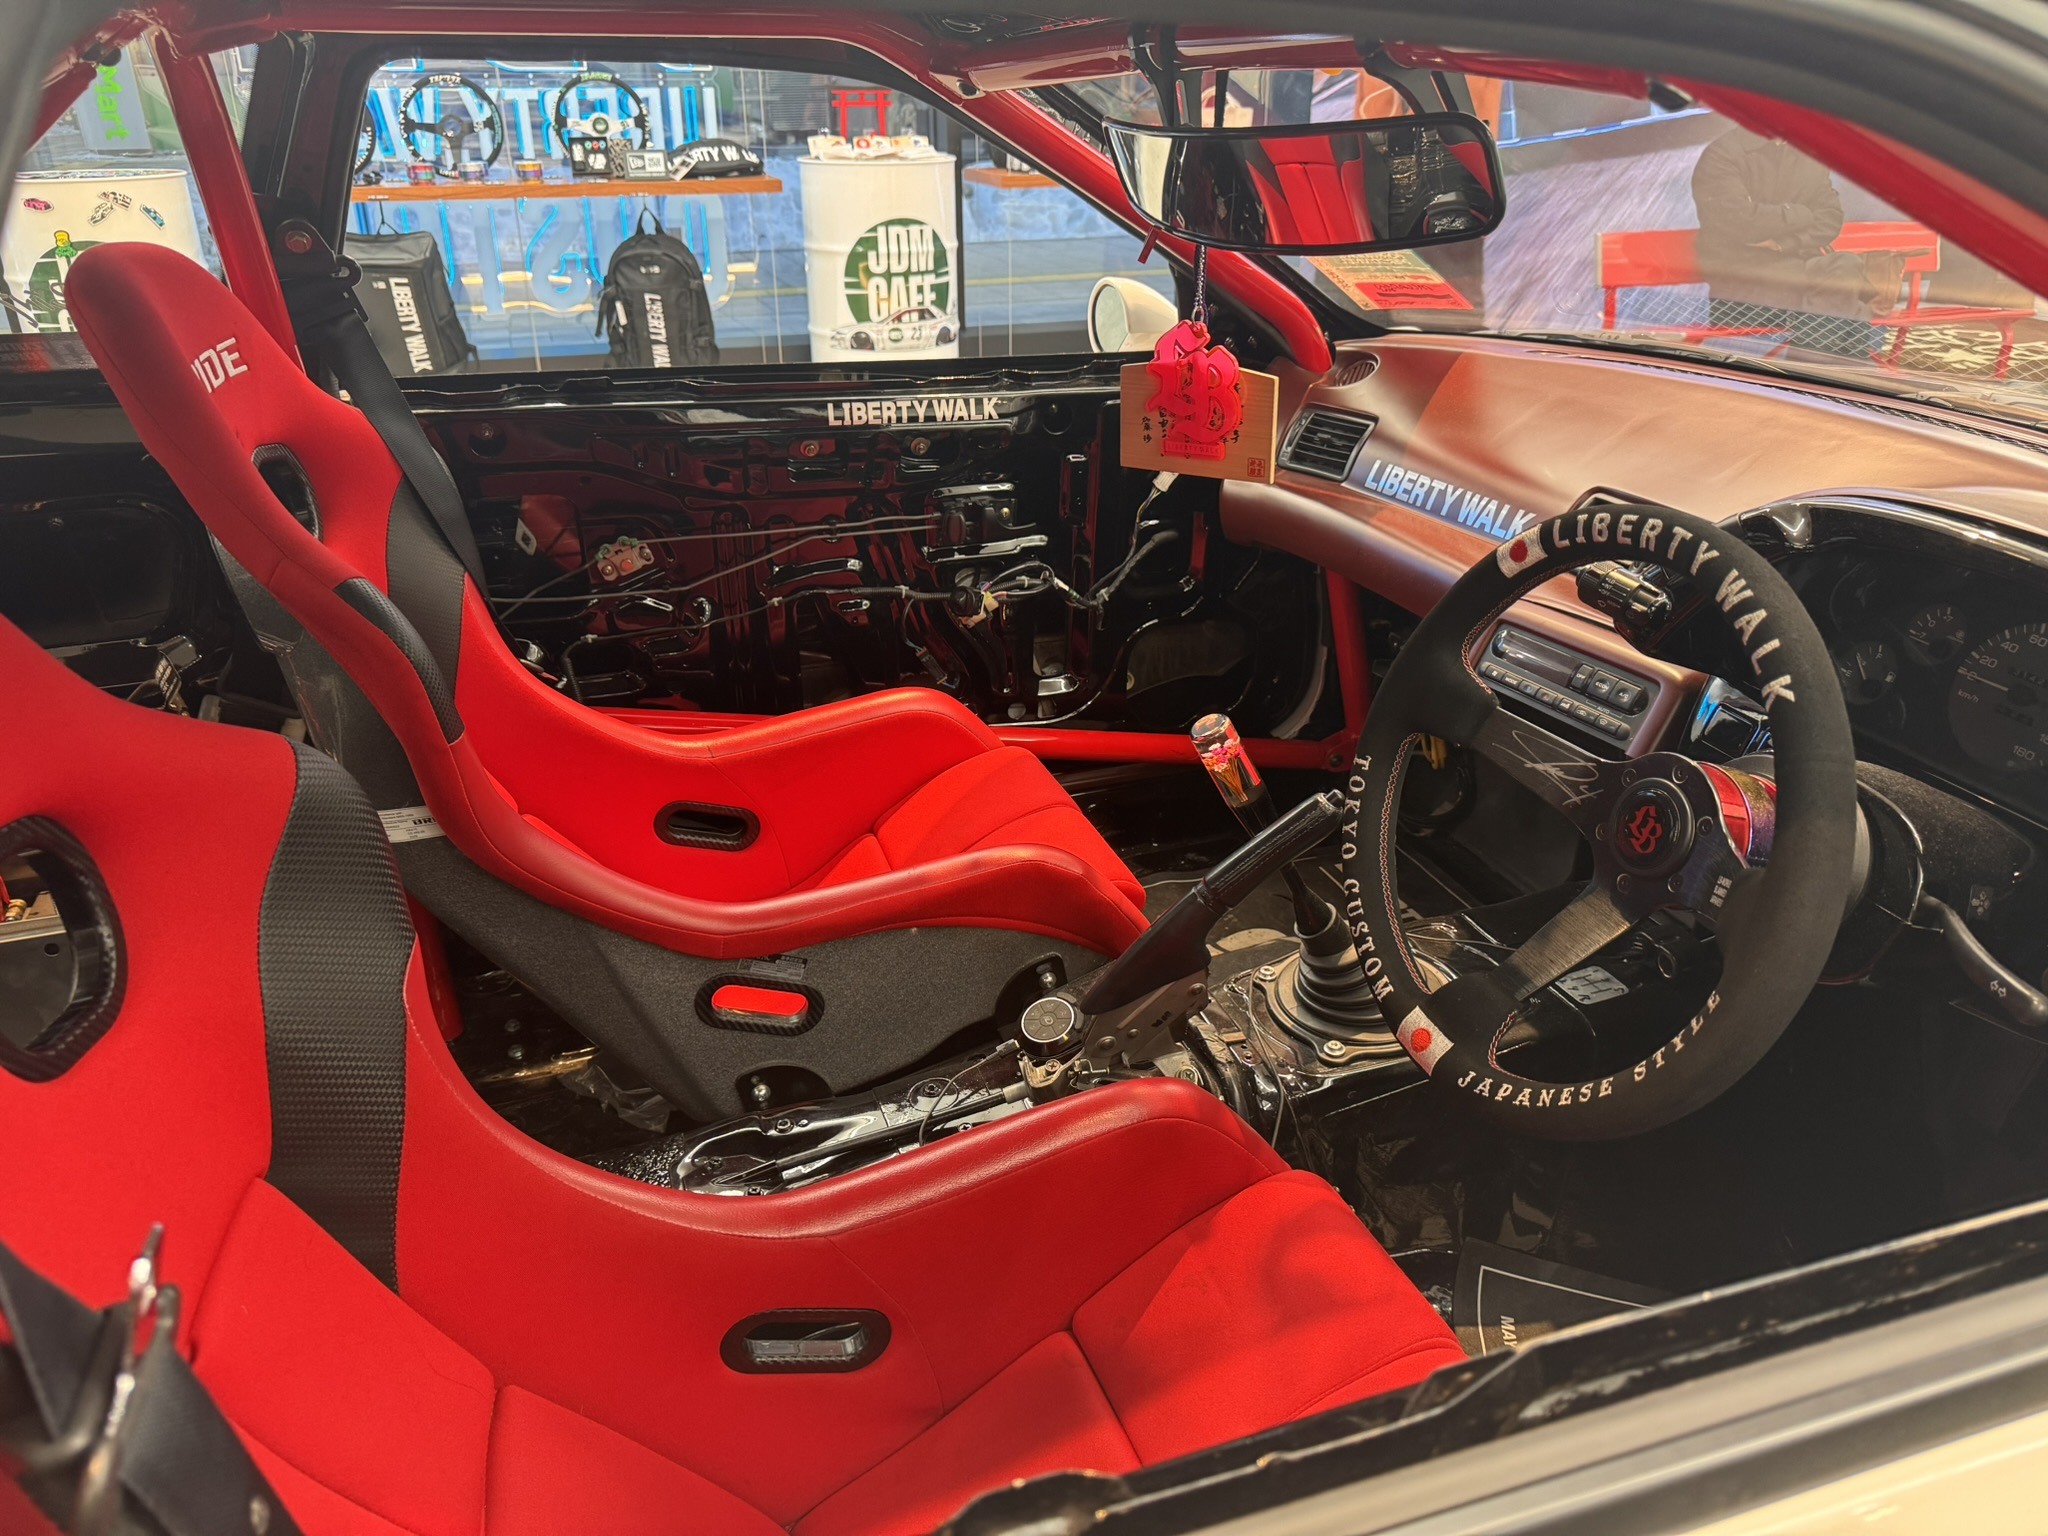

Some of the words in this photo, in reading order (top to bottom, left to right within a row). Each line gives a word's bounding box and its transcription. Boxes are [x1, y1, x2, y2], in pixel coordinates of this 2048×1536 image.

[867, 223, 935, 274] JDM
[388, 277, 423, 332] LIBERTY
[643, 292, 668, 343] LIBERTY
[190, 336, 249, 394] IDE
[404, 334, 433, 374] WALK
[826, 400, 928, 426] LIBERTY
[931, 397, 1000, 422] WALK
[1364, 459, 1465, 517] LIBERTY
[1456, 490, 1537, 541] WALK
[1552, 512, 1720, 577] LIBERTY
[1715, 568, 1796, 713] WALK
[1979, 655, 1998, 669] 20
[2000, 641, 2020, 654] 40
[2028, 633, 2048, 648] 60
[1594, 681, 1611, 691] ECON
[1618, 692, 1630, 701] A/C
[1957, 689, 1980, 703] km/h
[1597, 705, 1611, 715] AUTO
[1341, 753, 1373, 861] TOKYO
[1343, 878, 1395, 1003] CUSTOM
[1457, 1070, 1615, 1108] JAPANESE
[1633, 990, 1721, 1082] STYLE
